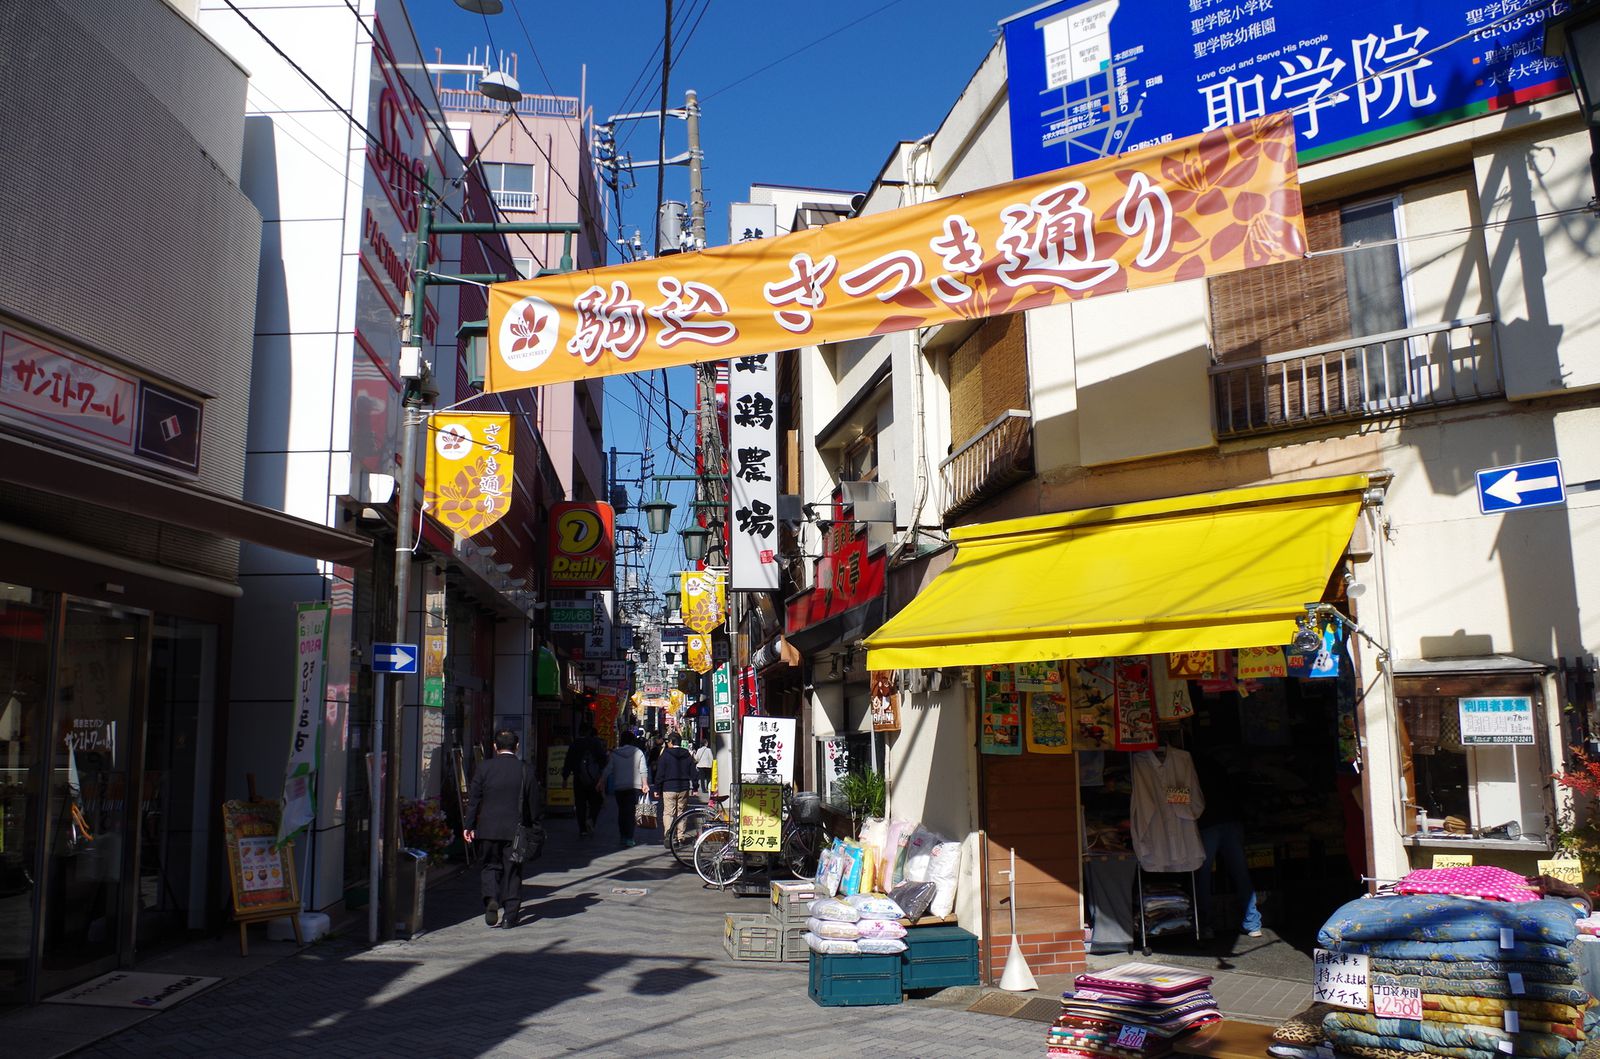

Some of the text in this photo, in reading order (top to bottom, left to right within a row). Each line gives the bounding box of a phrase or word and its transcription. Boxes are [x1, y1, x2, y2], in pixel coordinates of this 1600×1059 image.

[1193, 17, 1276, 59] 聖学院幼稚園
[1197, 33, 1329, 82] Love God and Serve His People
[1484, 36, 1544, 66] 聖学院広
[1197, 23, 1438, 140] 聖学院
[568, 170, 1176, 365] 駒込 さつき通り
[12, 359, 125, 425] サンエトワール
[480, 423, 505, 513] さつき通り
[553, 556, 607, 580] Daily
[1464, 699, 1527, 712] 利用者募集
[743, 788, 754, 827] 炒飯
[755, 787, 768, 827] ギョーザ
[769, 788, 780, 828] ラーメン
[740, 835, 778, 849] 珍々亭
[1315, 950, 1360, 967] 自転車を
[1319, 967, 1367, 985] 持ったままは
